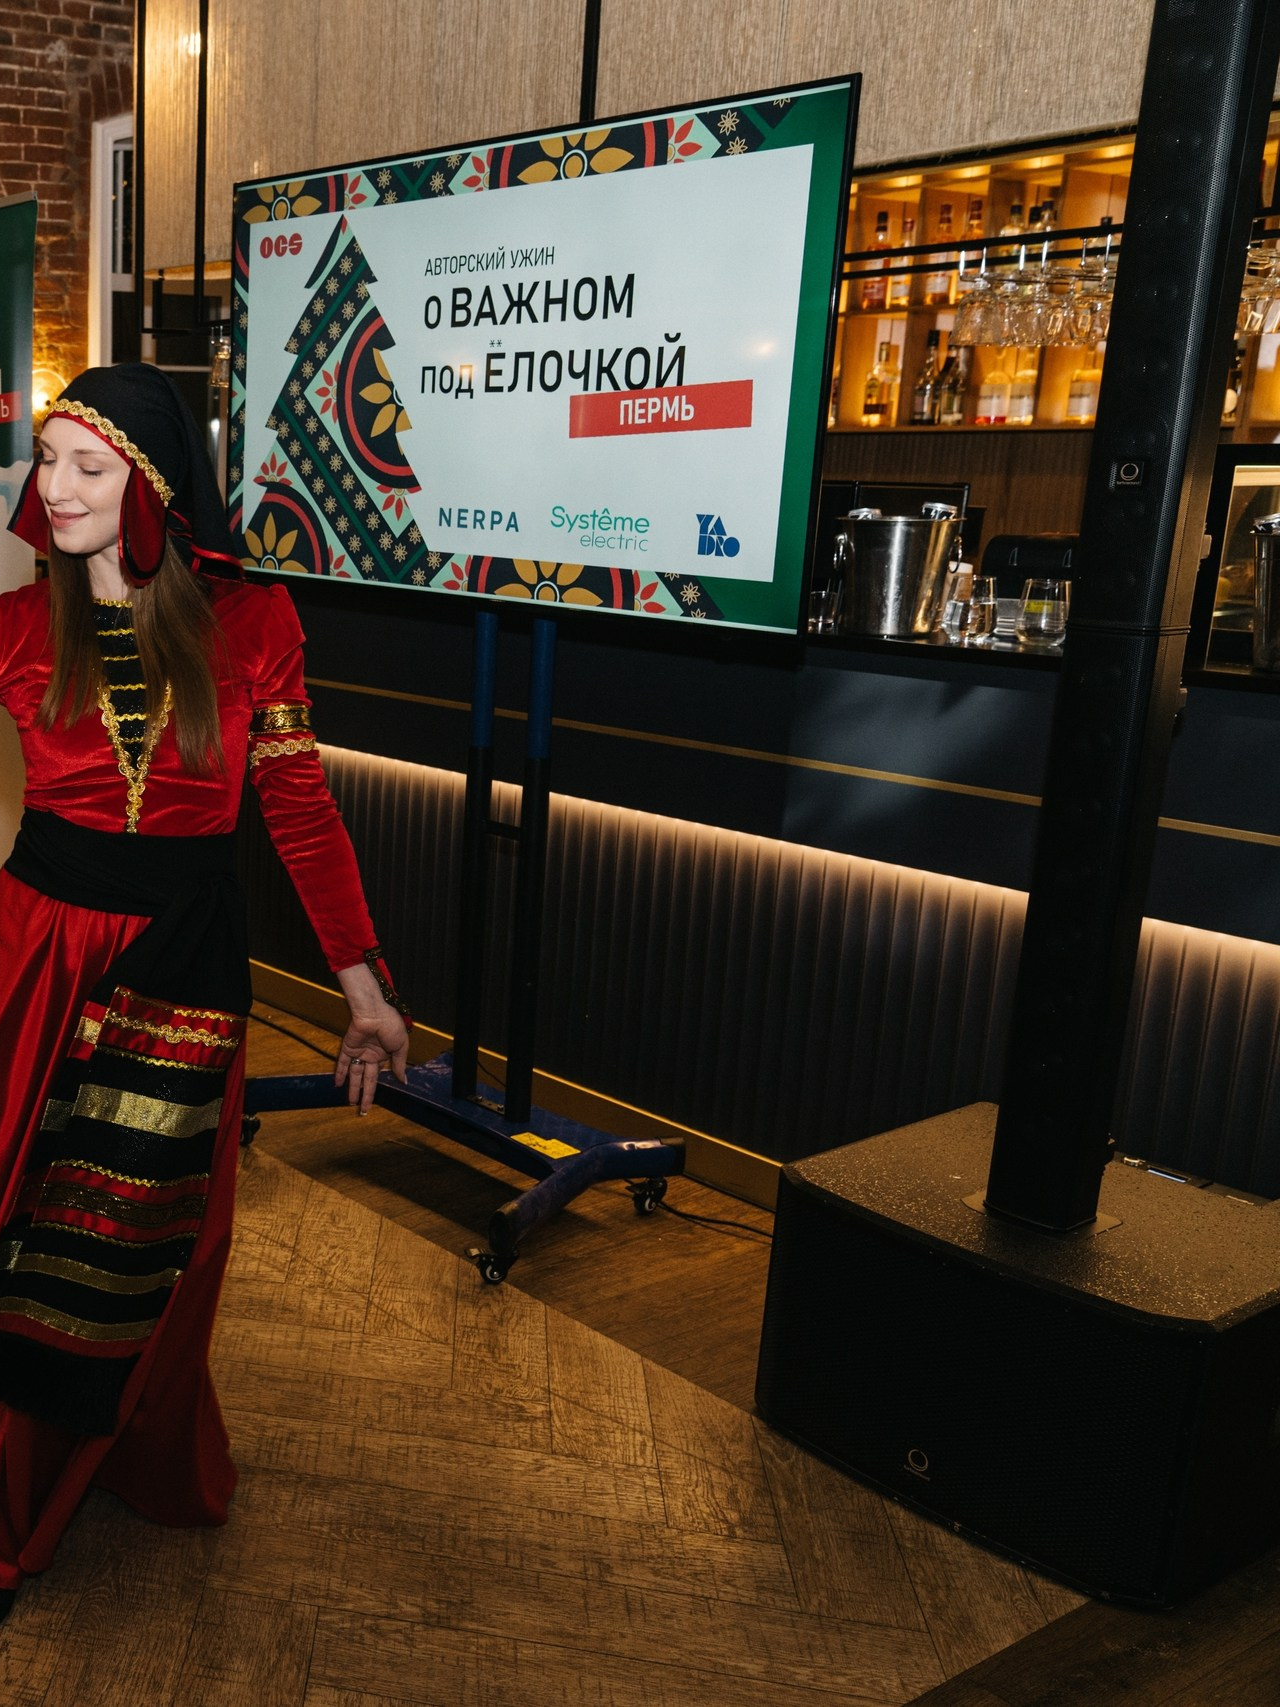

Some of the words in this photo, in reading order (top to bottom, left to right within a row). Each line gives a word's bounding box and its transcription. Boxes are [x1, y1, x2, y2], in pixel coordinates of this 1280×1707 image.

[259, 232, 303, 259] OCS
[423, 246, 506, 277] АВТОРСКИЙ
[509, 246, 555, 270] УЖИН
[450, 273, 636, 329] ВАЖНОМ
[484, 332, 687, 394] ЁЛОЧКОЙ
[619, 394, 696, 426] ПЕРМЬ
[438, 507, 520, 533] NERPA
[550, 505, 650, 534] Systême
[579, 531, 648, 552] electric
